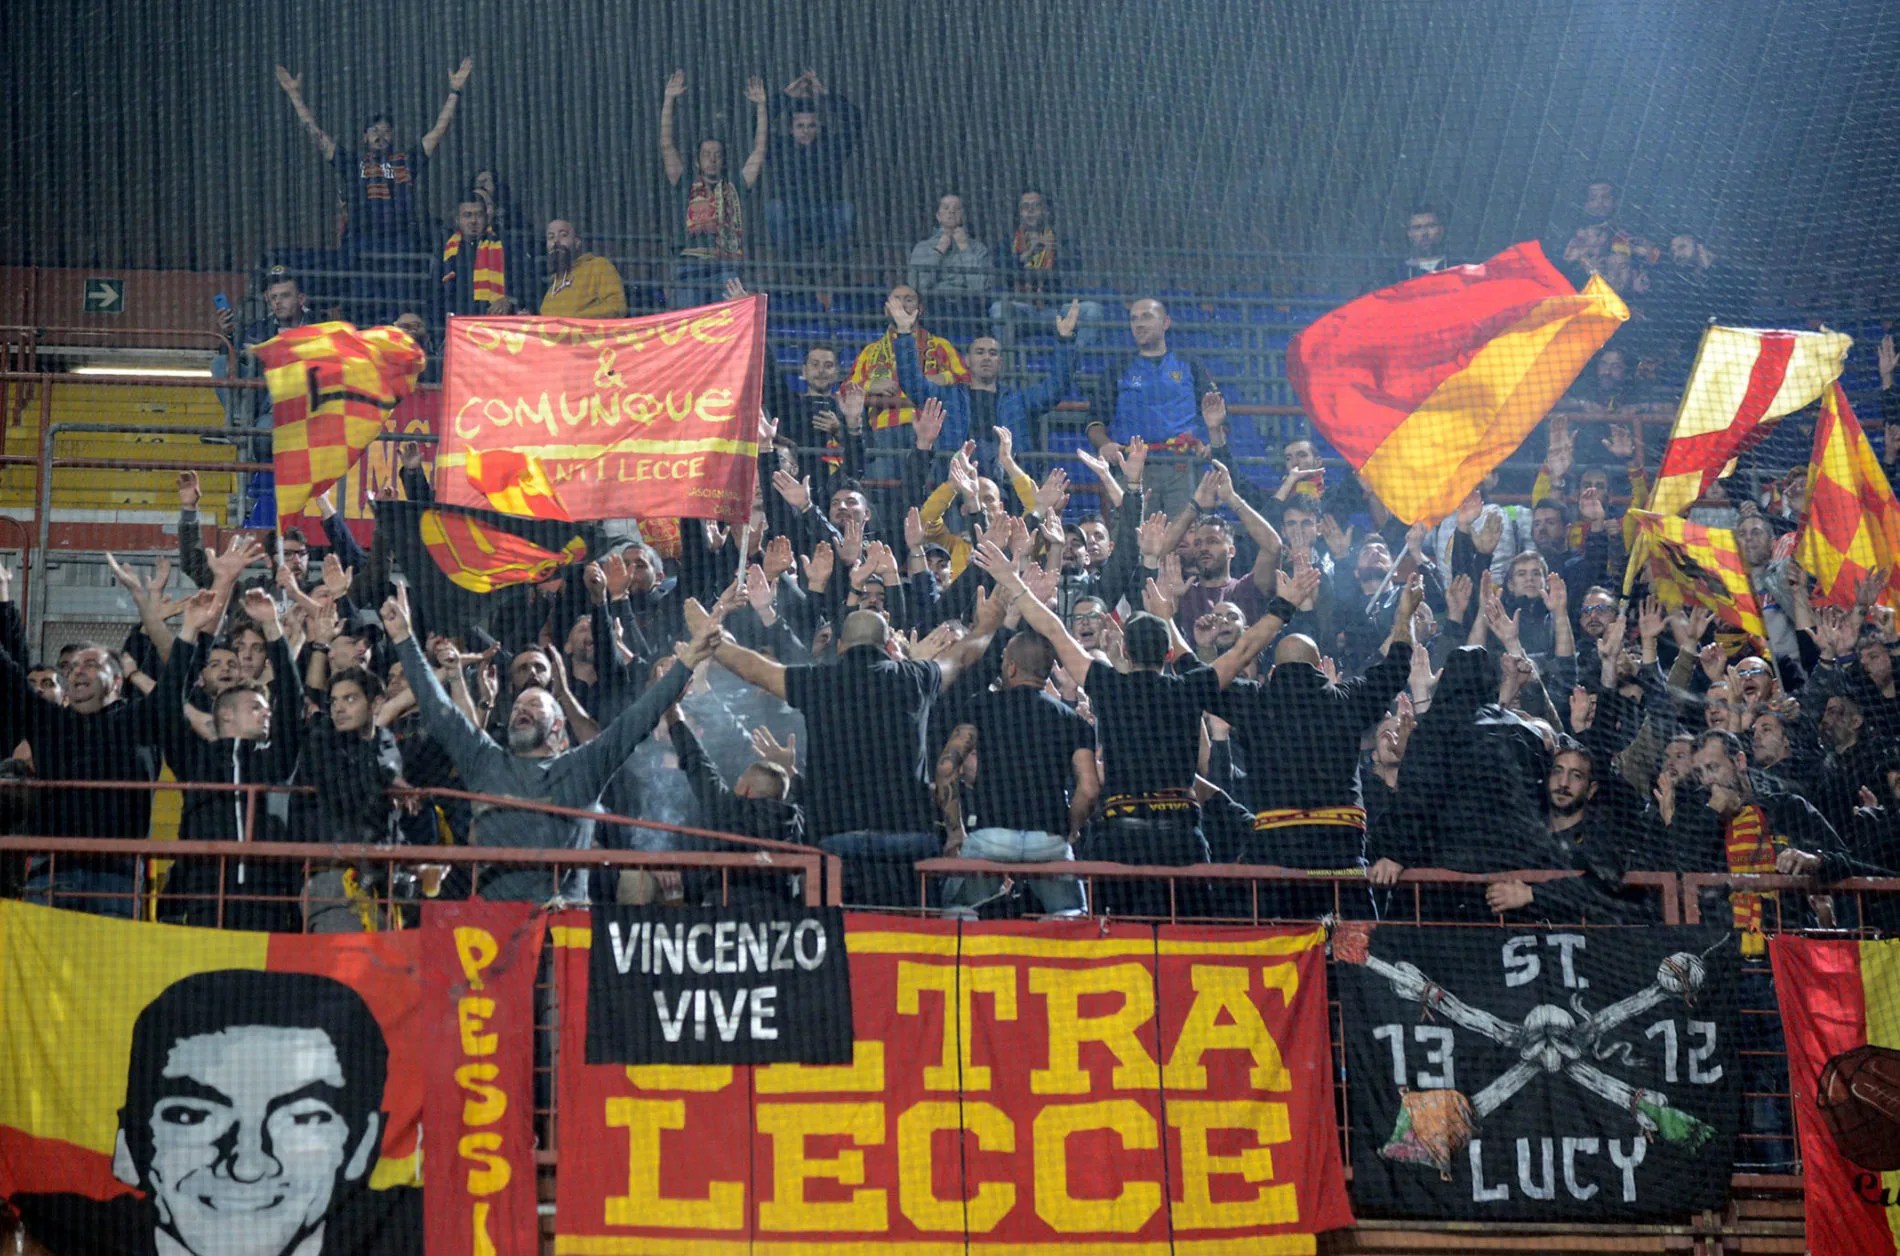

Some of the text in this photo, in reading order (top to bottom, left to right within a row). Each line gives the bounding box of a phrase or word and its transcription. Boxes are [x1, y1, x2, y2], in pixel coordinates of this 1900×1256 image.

[593, 348, 628, 388] &
[454, 387, 737, 439] COMUNQUE
[617, 456, 705, 483] LECCE
[608, 918, 826, 975] VINCENZO
[653, 985, 778, 1042] VIVE
[1373, 1019, 1723, 1089] 13 12
[604, 1096, 1299, 1233] LECCE
[1469, 1137, 1646, 1203] LUCY
